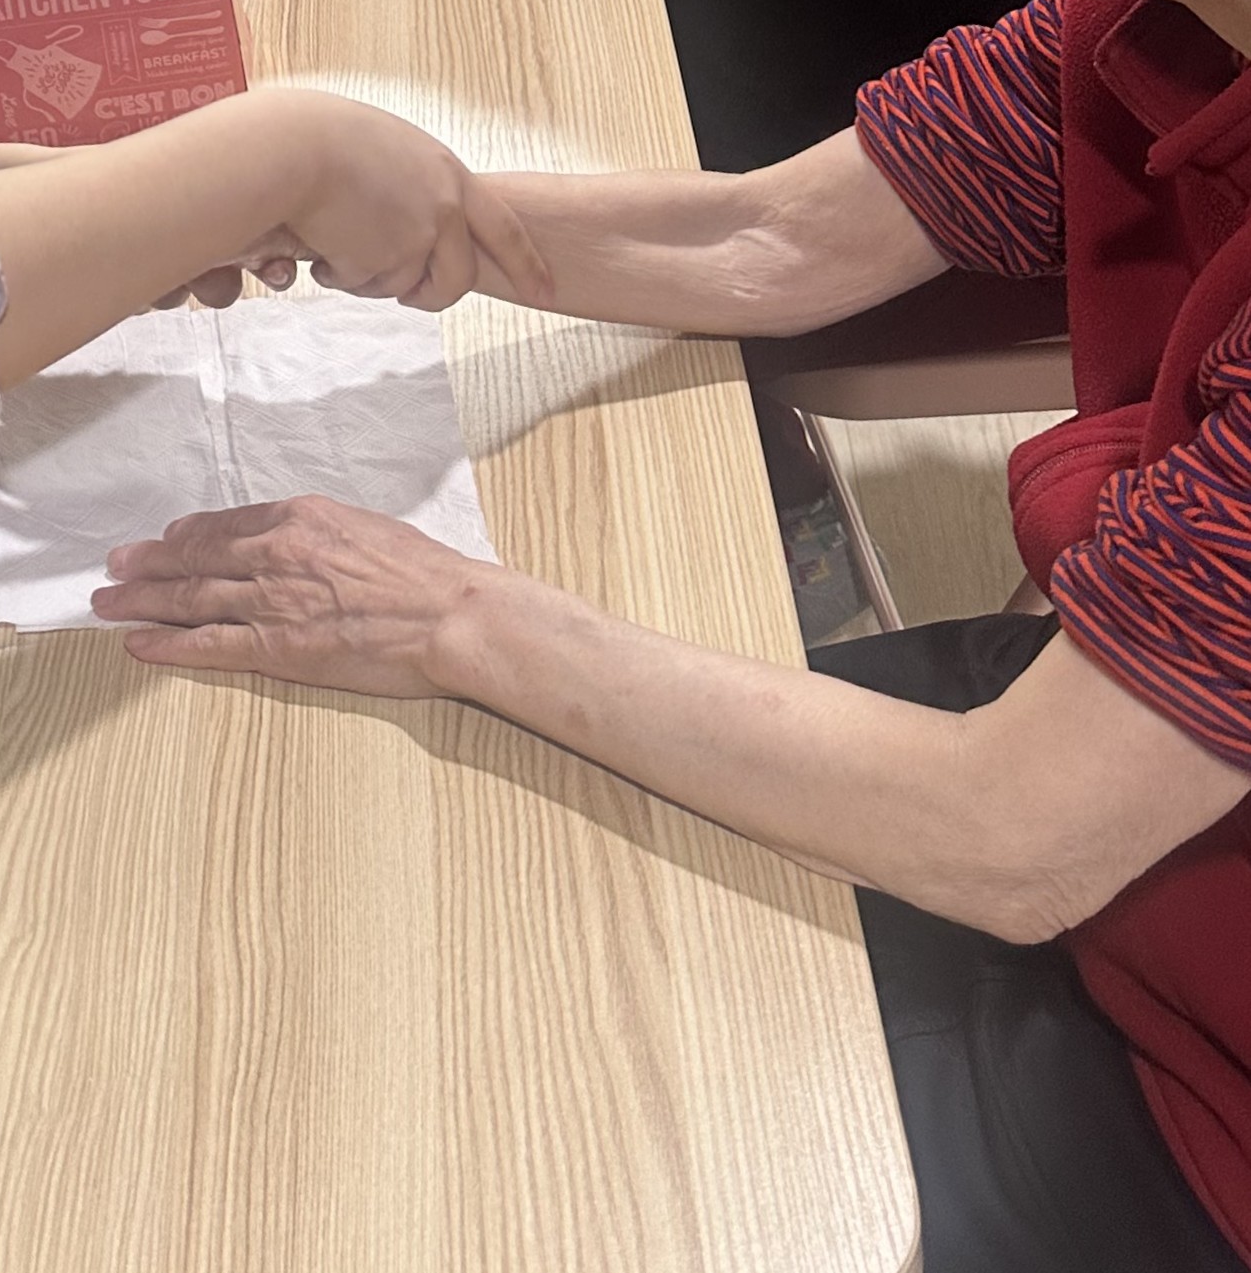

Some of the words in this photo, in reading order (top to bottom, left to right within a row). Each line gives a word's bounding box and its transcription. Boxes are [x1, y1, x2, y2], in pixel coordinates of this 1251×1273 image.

[143, 46, 229, 69] BREAKFAST
[94, 90, 165, 119] C'EST
[171, 79, 236, 109] BON
